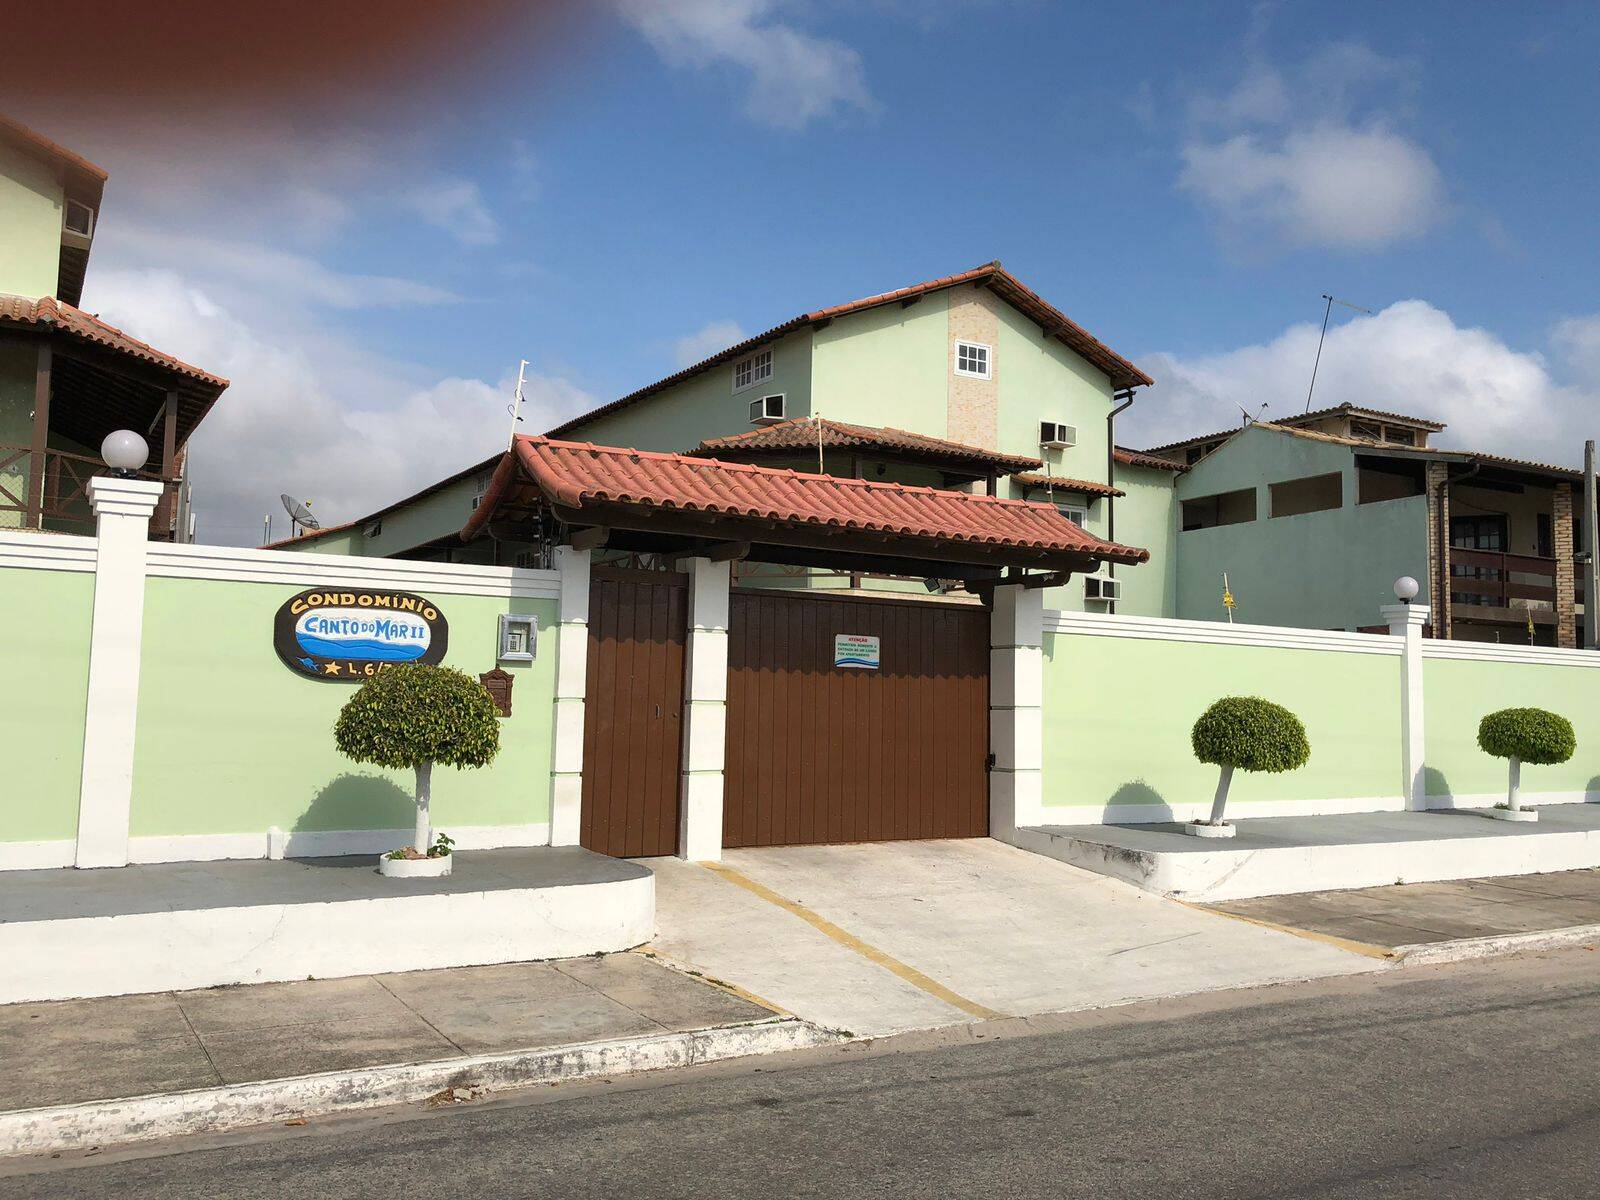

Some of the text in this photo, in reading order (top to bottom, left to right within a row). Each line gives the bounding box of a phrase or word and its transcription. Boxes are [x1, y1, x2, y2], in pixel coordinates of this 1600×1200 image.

[304, 616, 425, 640] CANTO DO MAR II
